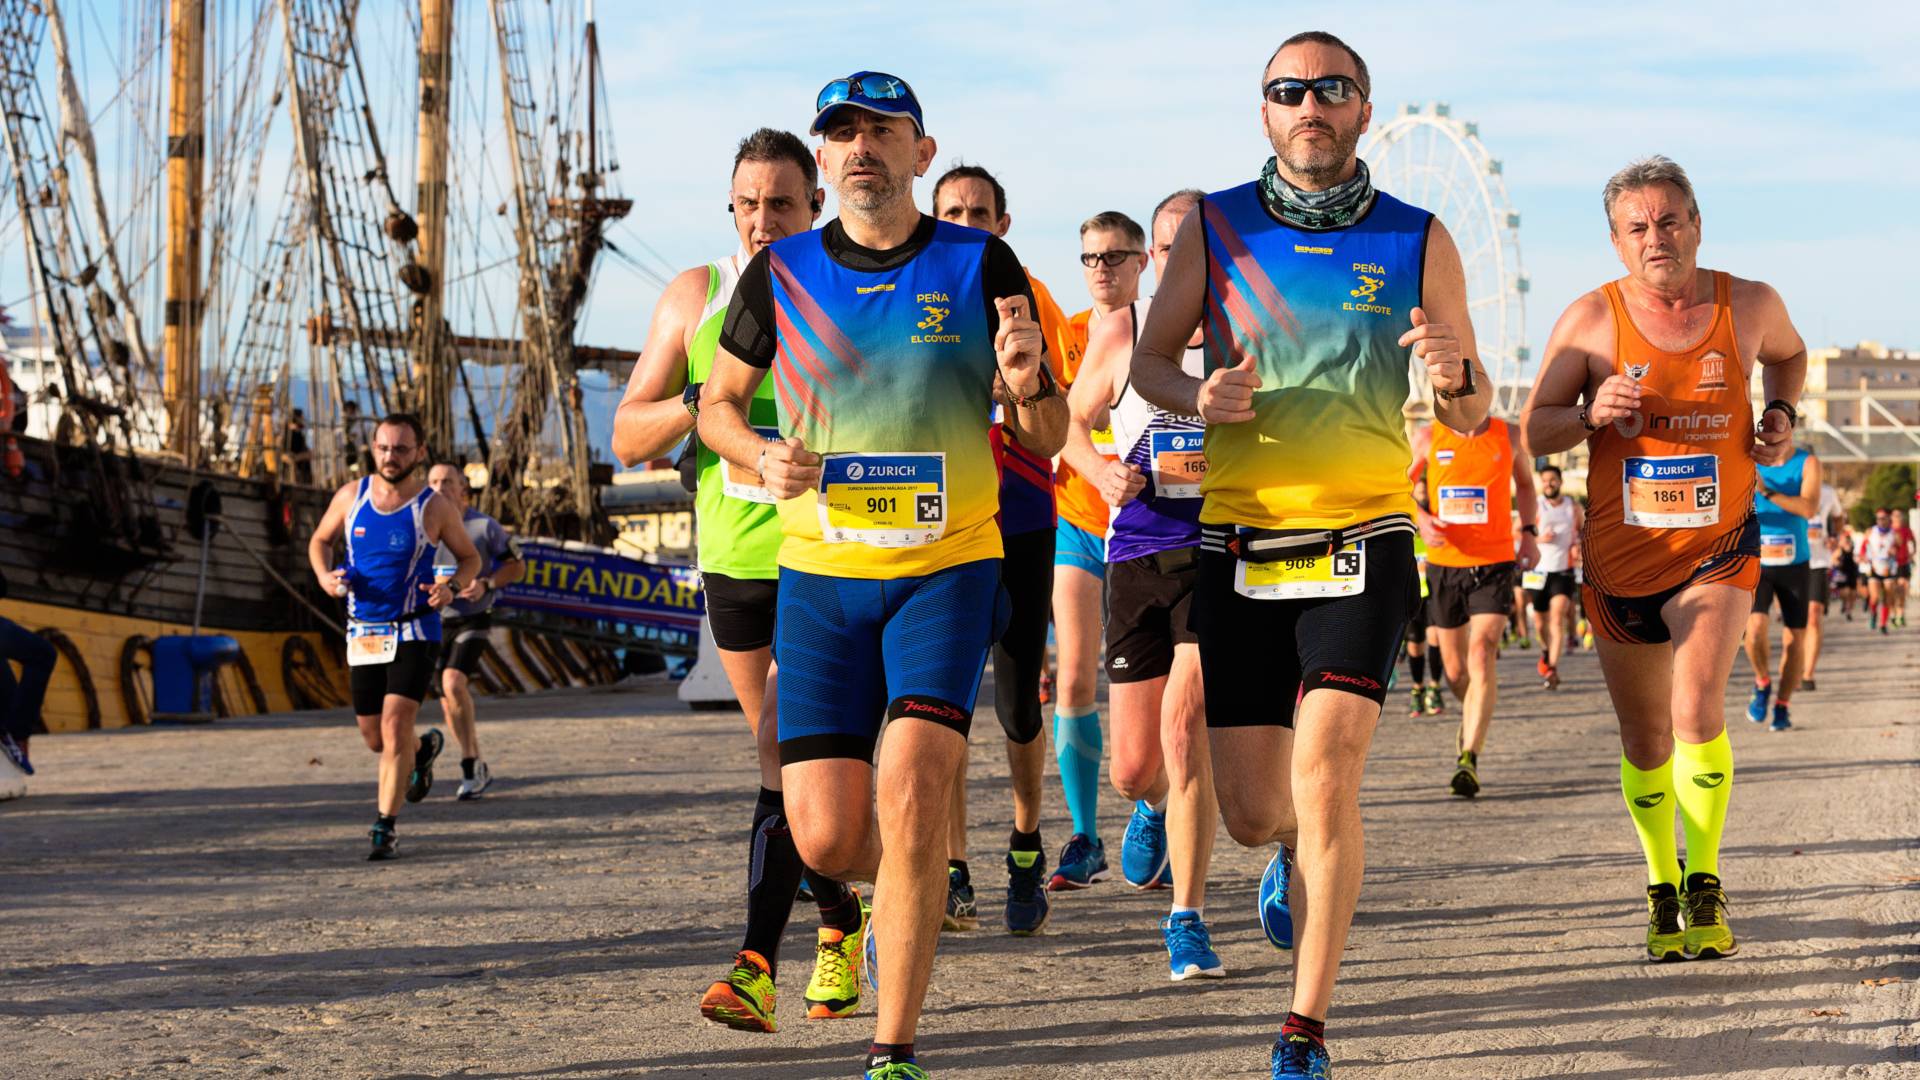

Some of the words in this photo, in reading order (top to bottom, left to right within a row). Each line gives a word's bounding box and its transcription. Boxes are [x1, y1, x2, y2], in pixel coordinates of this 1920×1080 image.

[1352, 262, 1386, 275] PEÑA
[917, 292, 950, 303] PEÑA
[1342, 302, 1354, 311] EL
[1355, 303, 1392, 316] COYOTE
[911, 335, 922, 343] EL
[924, 334, 961, 343] COYOTE
[1187, 438, 1204, 447] ZU
[868, 465, 916, 476] ZURICH
[1656, 465, 1695, 475] ZURICH
[1653, 490, 1684, 502] 1861
[866, 497, 896, 513] 901
[1285, 557, 1315, 571] 908
